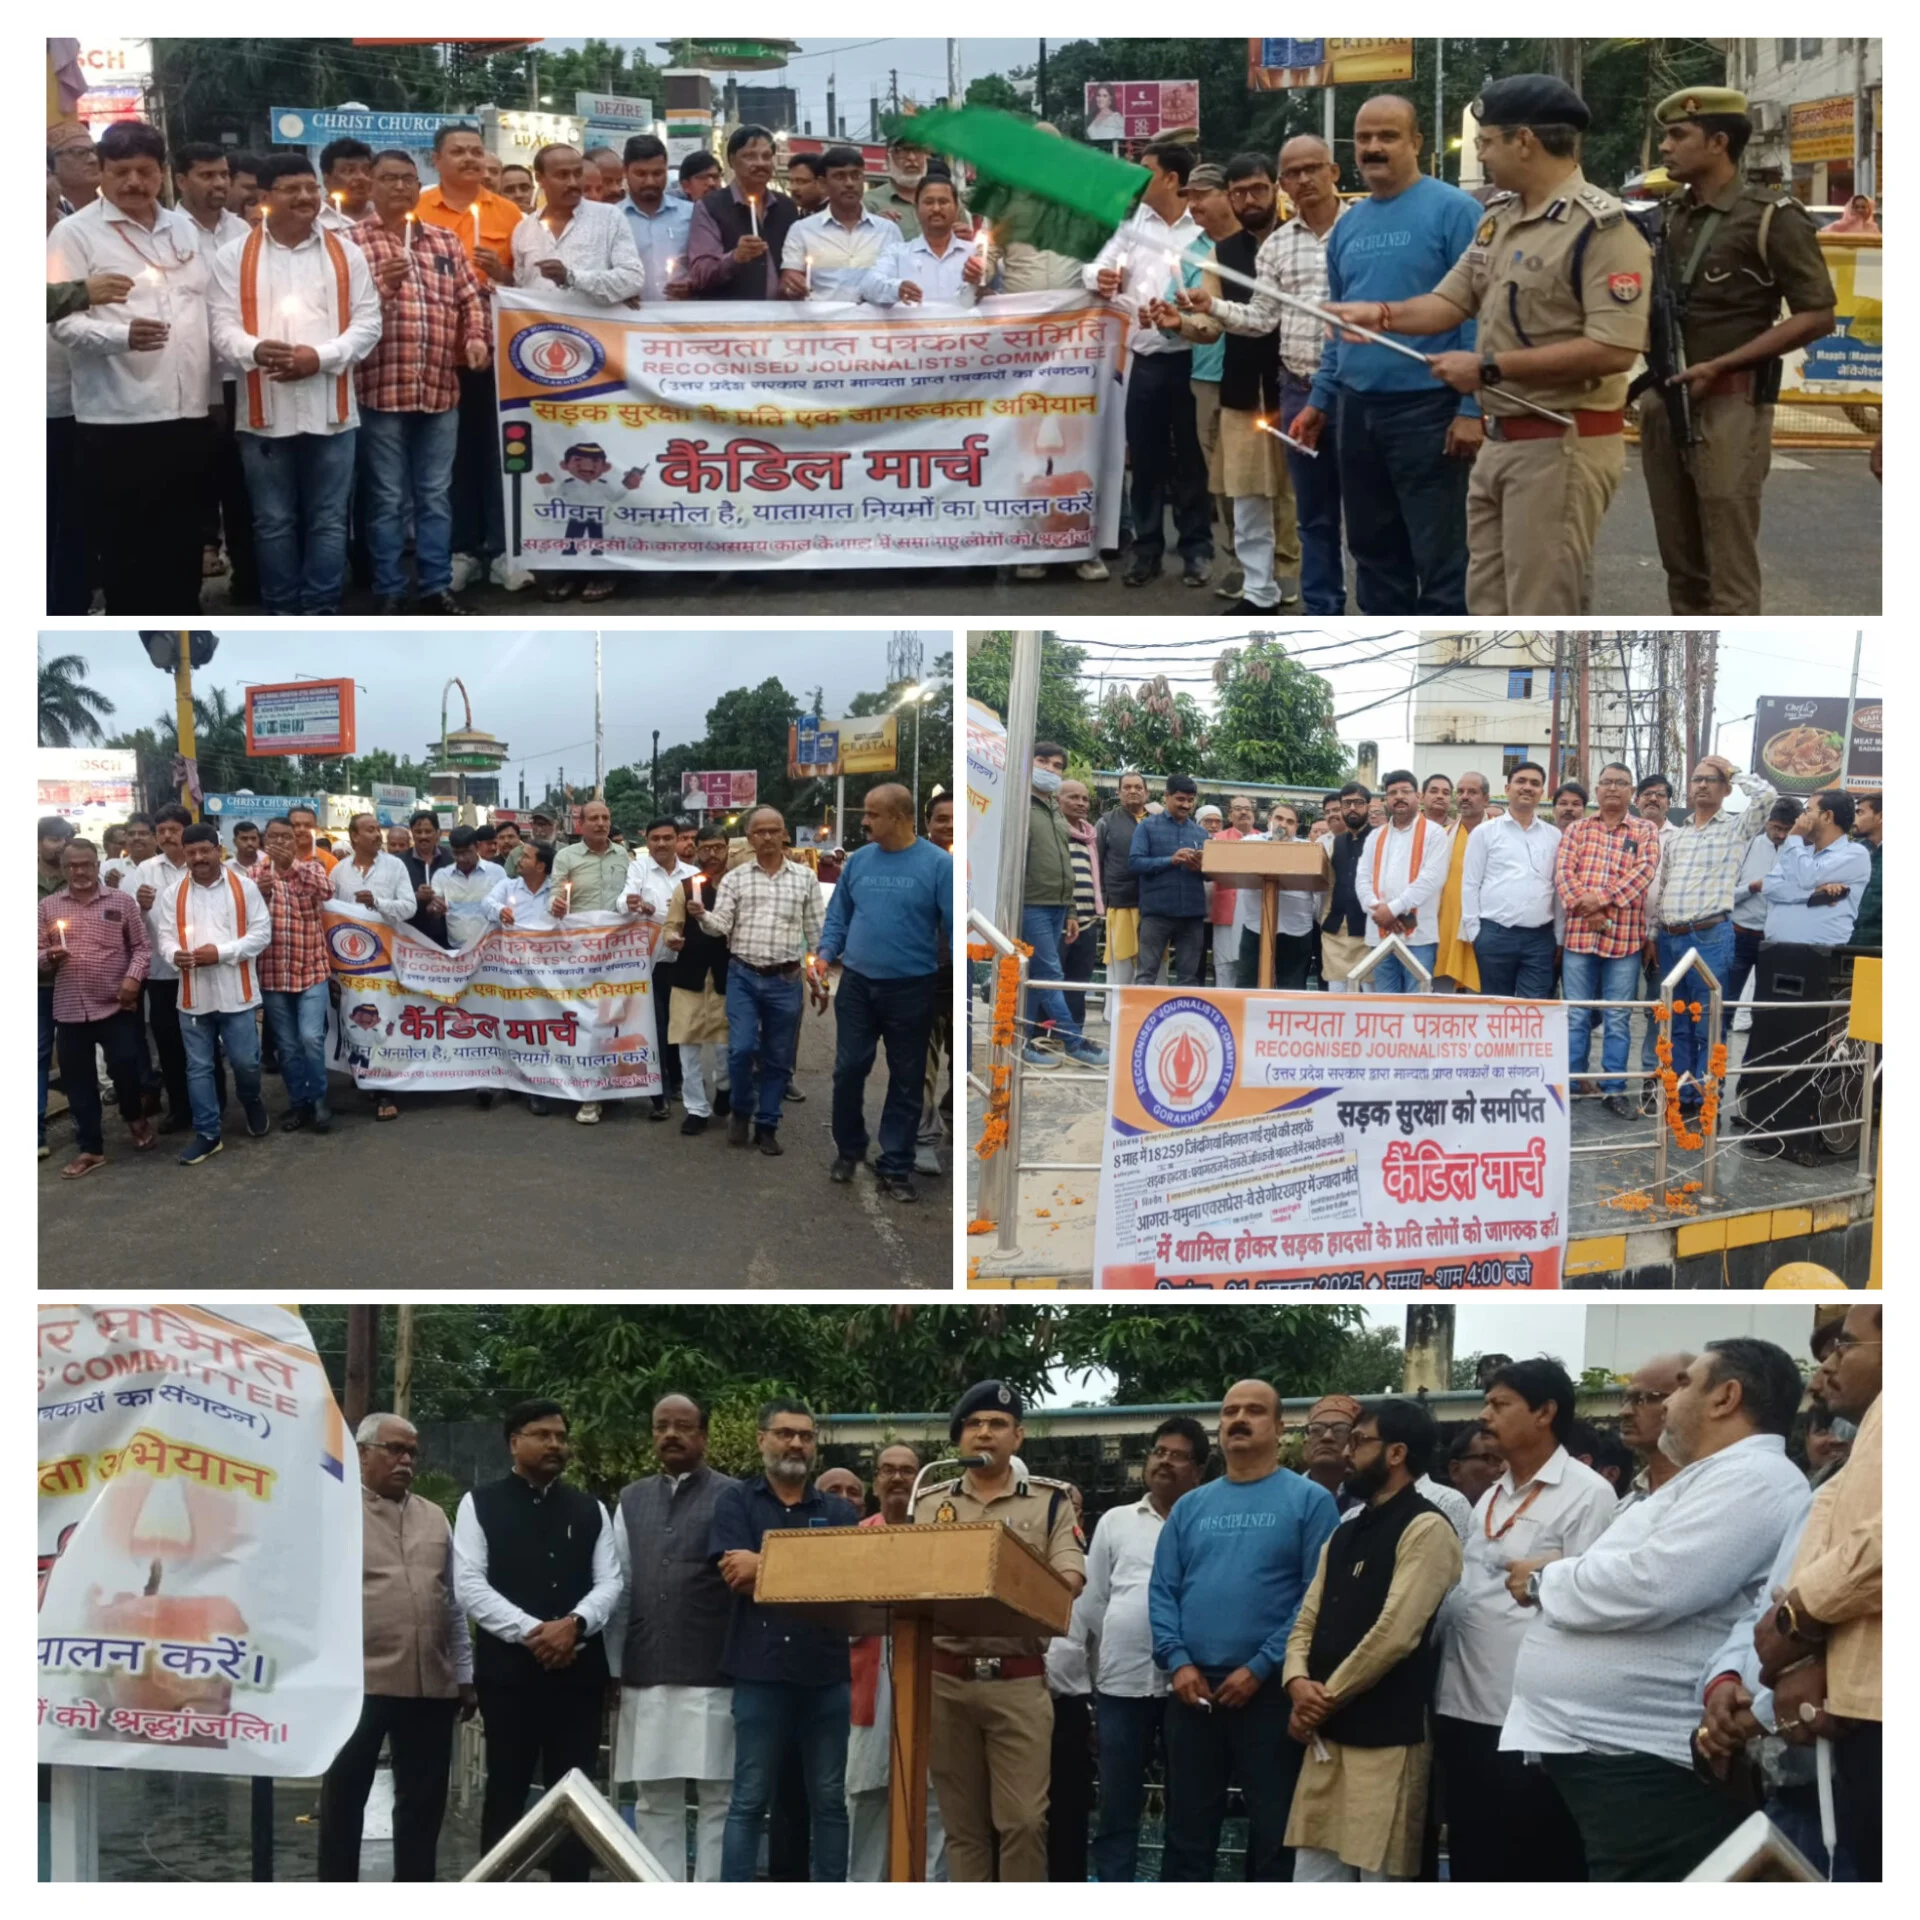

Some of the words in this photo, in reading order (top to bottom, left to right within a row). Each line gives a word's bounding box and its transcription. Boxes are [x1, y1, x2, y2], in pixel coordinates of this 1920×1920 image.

[312, 113, 374, 129] CHRIST
[594, 100, 643, 118] DEZIRE
[641, 338, 771, 358] मान्यता
[784, 335, 858, 358] प्राप्त
[872, 331, 990, 355] पत्रकार
[1003, 318, 1107, 346] समिति
[643, 361, 798, 375] RECOGNISED
[806, 354, 974, 374] JOURNALISTS'
[980, 346, 1107, 367] COMMITTEE
[751, 379, 807, 391] सरकार
[850, 376, 904, 389] मान्यता
[1012, 370, 1035, 380] का
[535, 402, 609, 427] सड़क
[618, 403, 690, 428] सुरक्षा
[735, 404, 784, 428] प्रति
[795, 410, 840, 428] एक
[992, 391, 1096, 416] अभियान
[656, 437, 851, 494] कैंडिल
[863, 433, 989, 489] मार्च
[533, 497, 604, 522] जीवन
[613, 500, 709, 523] अनमोल
[717, 499, 743, 523] है,
[752, 502, 854, 522] यातायात
[862, 495, 934, 518] नियमों
[942, 499, 974, 516] का
[984, 498, 1049, 516] पालन
[523, 537, 568, 553] सड़क
[655, 540, 703, 553] कारण
[774, 538, 812, 551] काल
[226, 797, 260, 806] CHRIST
[576, 979, 648, 1000] अभियान
[399, 1005, 500, 1041] कैंडिल
[503, 1011, 579, 1047] मार्च
[1268, 1009, 1345, 1038] मान्यता
[1355, 1012, 1404, 1039] प्राप्त
[1413, 1013, 1478, 1039] पत्रकार
[1486, 1004, 1544, 1039] समिति
[555, 1054, 571, 1066] का
[576, 1053, 617, 1067] पालन
[1133, 1016, 1156, 1095] RECOGNISED
[1218, 1025, 1235, 1095] COMMITTEE
[1255, 1042, 1362, 1057] RECOGNISED
[1366, 1042, 1471, 1059] JOURNALISTS'
[1475, 1042, 1553, 1058] COMMITTEE
[1265, 1063, 1296, 1085] (उत्तर
[1299, 1065, 1324, 1081] प्रदेश
[1328, 1066, 1366, 1080] सरकार
[1369, 1066, 1391, 1081] द्वारा
[1394, 1066, 1429, 1080] मान्यता
[1432, 1066, 1454, 1080] प्राप्त
[1456, 1063, 1489, 1079] पत्रकारों
[1492, 1067, 1504, 1079] का
[1507, 1063, 1545, 1083] संगठन)
[1153, 1101, 1215, 1125] GORAKHPUR
[1337, 1100, 1391, 1134] सड़क
[1396, 1100, 1448, 1135] सुरक्षा
[1452, 1090, 1476, 1124] को
[1480, 1088, 1546, 1124] समर्पित
[1113, 1155, 1121, 1169] 8
[1121, 1151, 1139, 1166] माह
[1140, 1146, 1148, 1163] में
[1148, 1143, 1184, 1162] 18259
[1222, 1131, 1248, 1148] निगल
[1249, 1124, 1262, 1143] गई
[1264, 1123, 1278, 1143] सूबे
[1278, 1120, 1290, 1137] की
[1265, 1181, 1307, 1202] गोरखपुर
[1307, 1173, 1317, 1193] में
[1316, 1173, 1341, 1190] ज्यादा
[1382, 1141, 1478, 1203] कैंडिल
[1481, 1137, 1546, 1199] मार्च
[1156, 1231, 1173, 1263] में
[1176, 1230, 1230, 1264] शामिल
[1235, 1229, 1277, 1263] होकर
[1281, 1232, 1323, 1261] सड़क
[1327, 1223, 1373, 1257] हादसों
[1376, 1221, 1392, 1249] के
[1395, 1218, 1422, 1249] प्रति
[1425, 1216, 1460, 1246] लोगों
[1462, 1215, 1481, 1244] को
[1385, 1270, 1424, 1289] समय
[1435, 1265, 1466, 1288] शाम
[1467, 1260, 1502, 1286] 4:00
[1504, 1254, 1532, 1285] बजे
[94, 1307, 300, 1391] समिति
[62, 1349, 299, 1418] COMMITTEE
[114, 1388, 154, 1409] का
[158, 1384, 271, 1440] संगठन)
[56, 1698, 101, 1729] को
[112, 1709, 288, 1743] श्रद्धांजलि।
